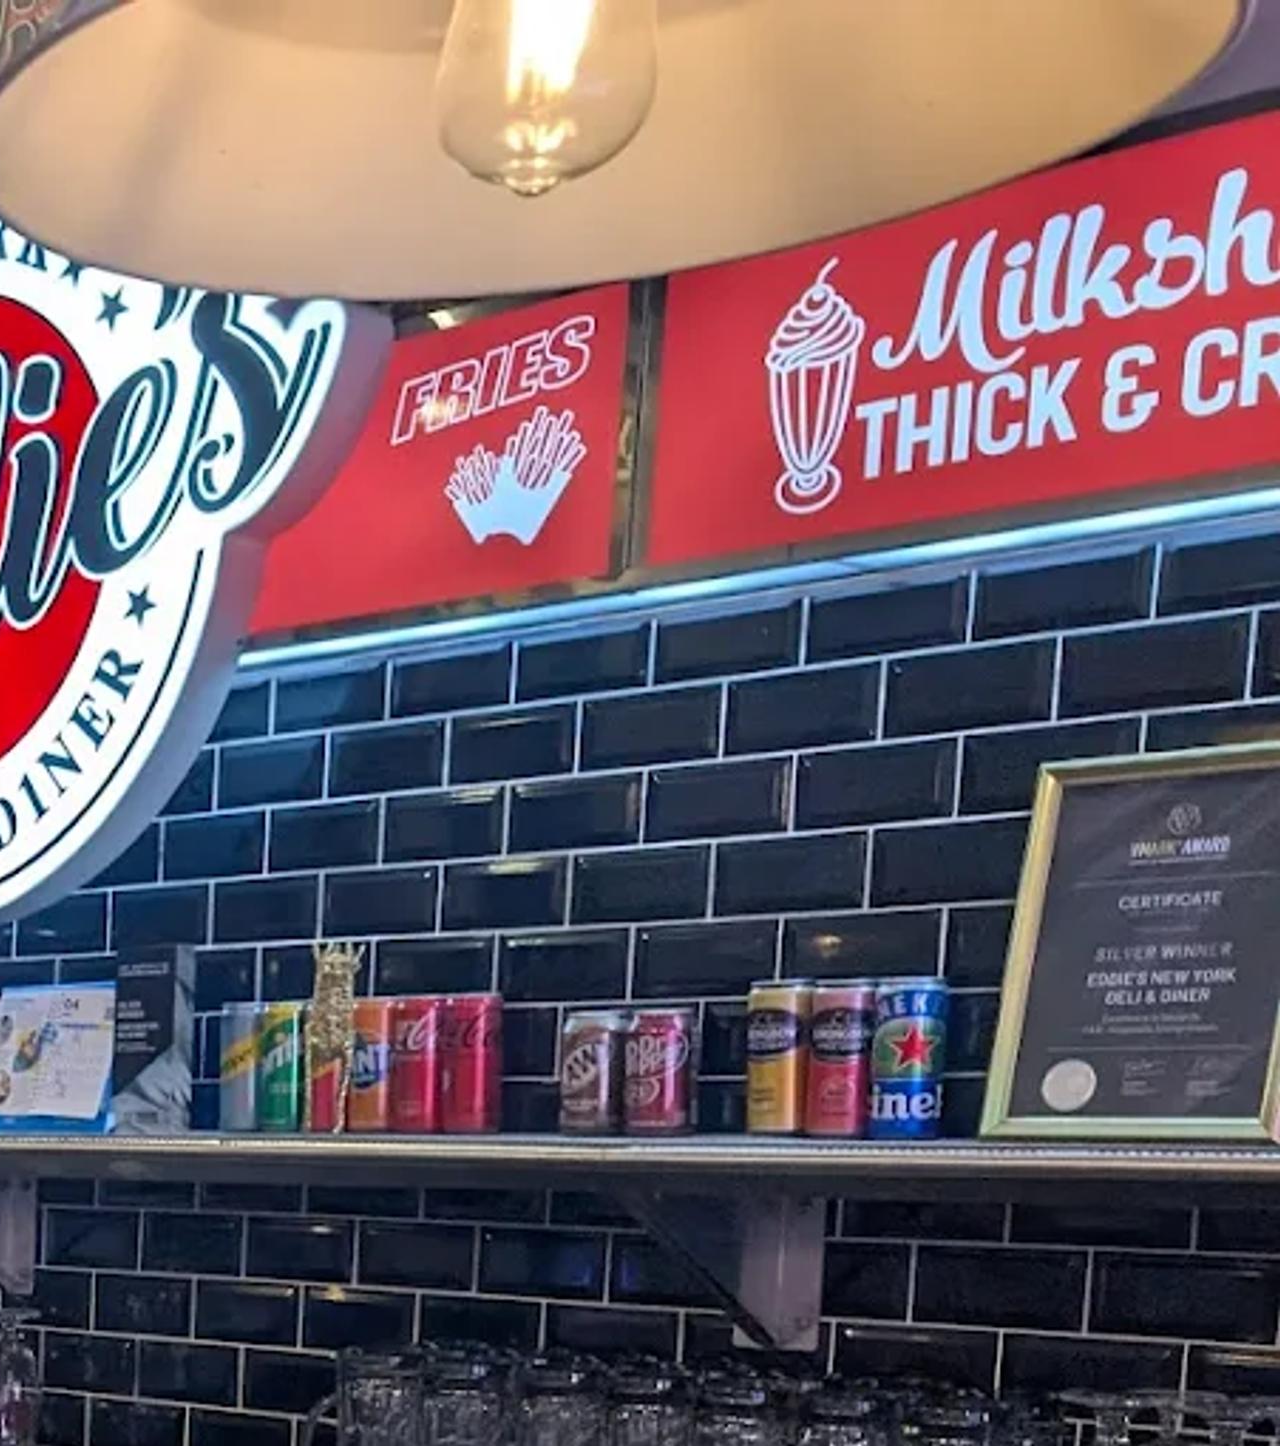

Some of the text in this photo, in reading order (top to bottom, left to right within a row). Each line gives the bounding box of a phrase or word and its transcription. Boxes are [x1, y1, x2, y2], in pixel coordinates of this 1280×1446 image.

[389, 314, 599, 448] FRIES
[855, 355, 1081, 482] THICK
[1102, 345, 1161, 432] &
[1118, 890, 1223, 911] CERTIFICATE
[1094, 941, 1234, 962] SILVER WINNER
[1150, 969, 1191, 986] NEW
[1192, 967, 1237, 984] YORK
[1104, 989, 1142, 1006] DELI
[1159, 986, 1212, 1004] DINER
